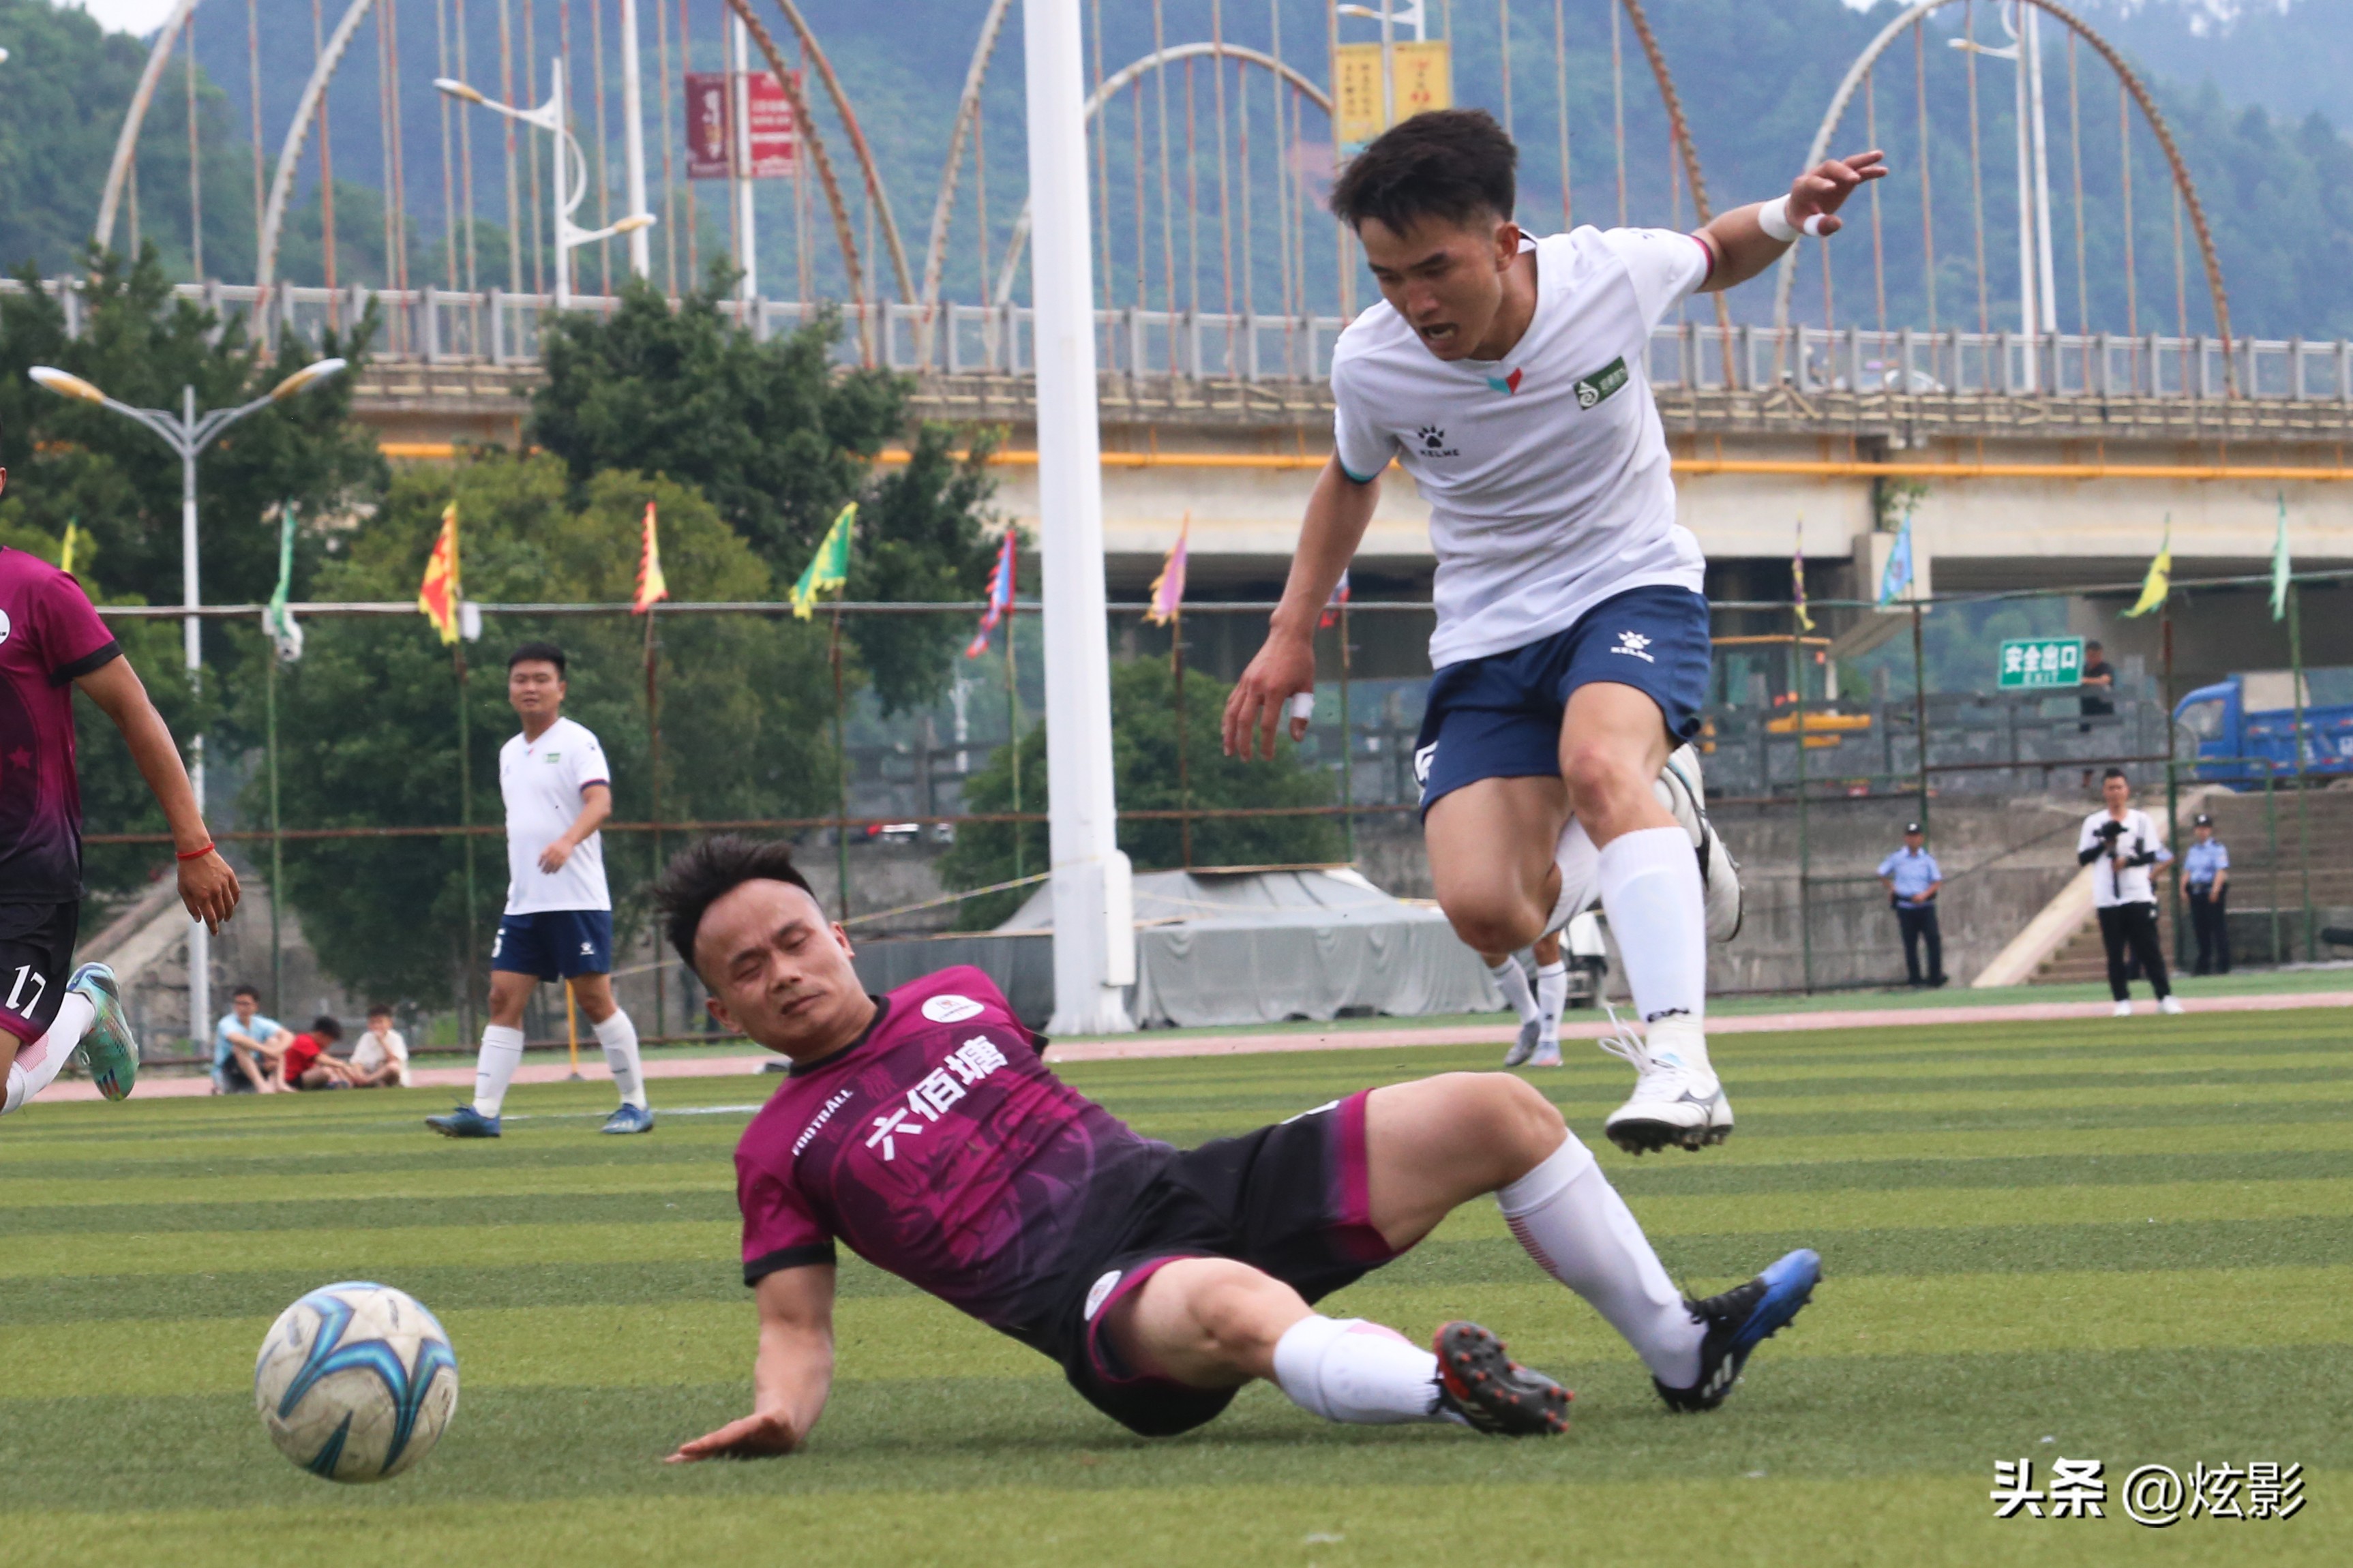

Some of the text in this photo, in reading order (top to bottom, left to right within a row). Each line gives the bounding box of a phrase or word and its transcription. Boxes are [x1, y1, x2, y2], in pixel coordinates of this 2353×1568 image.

[1420, 449, 1460, 457] KELME
[2005, 644, 2077, 673] 安全出口
[5, 965, 46, 1020] 17
[792, 1089, 853, 1156] FOOTBALL
[866, 1035, 1008, 1161] 六佰塘
